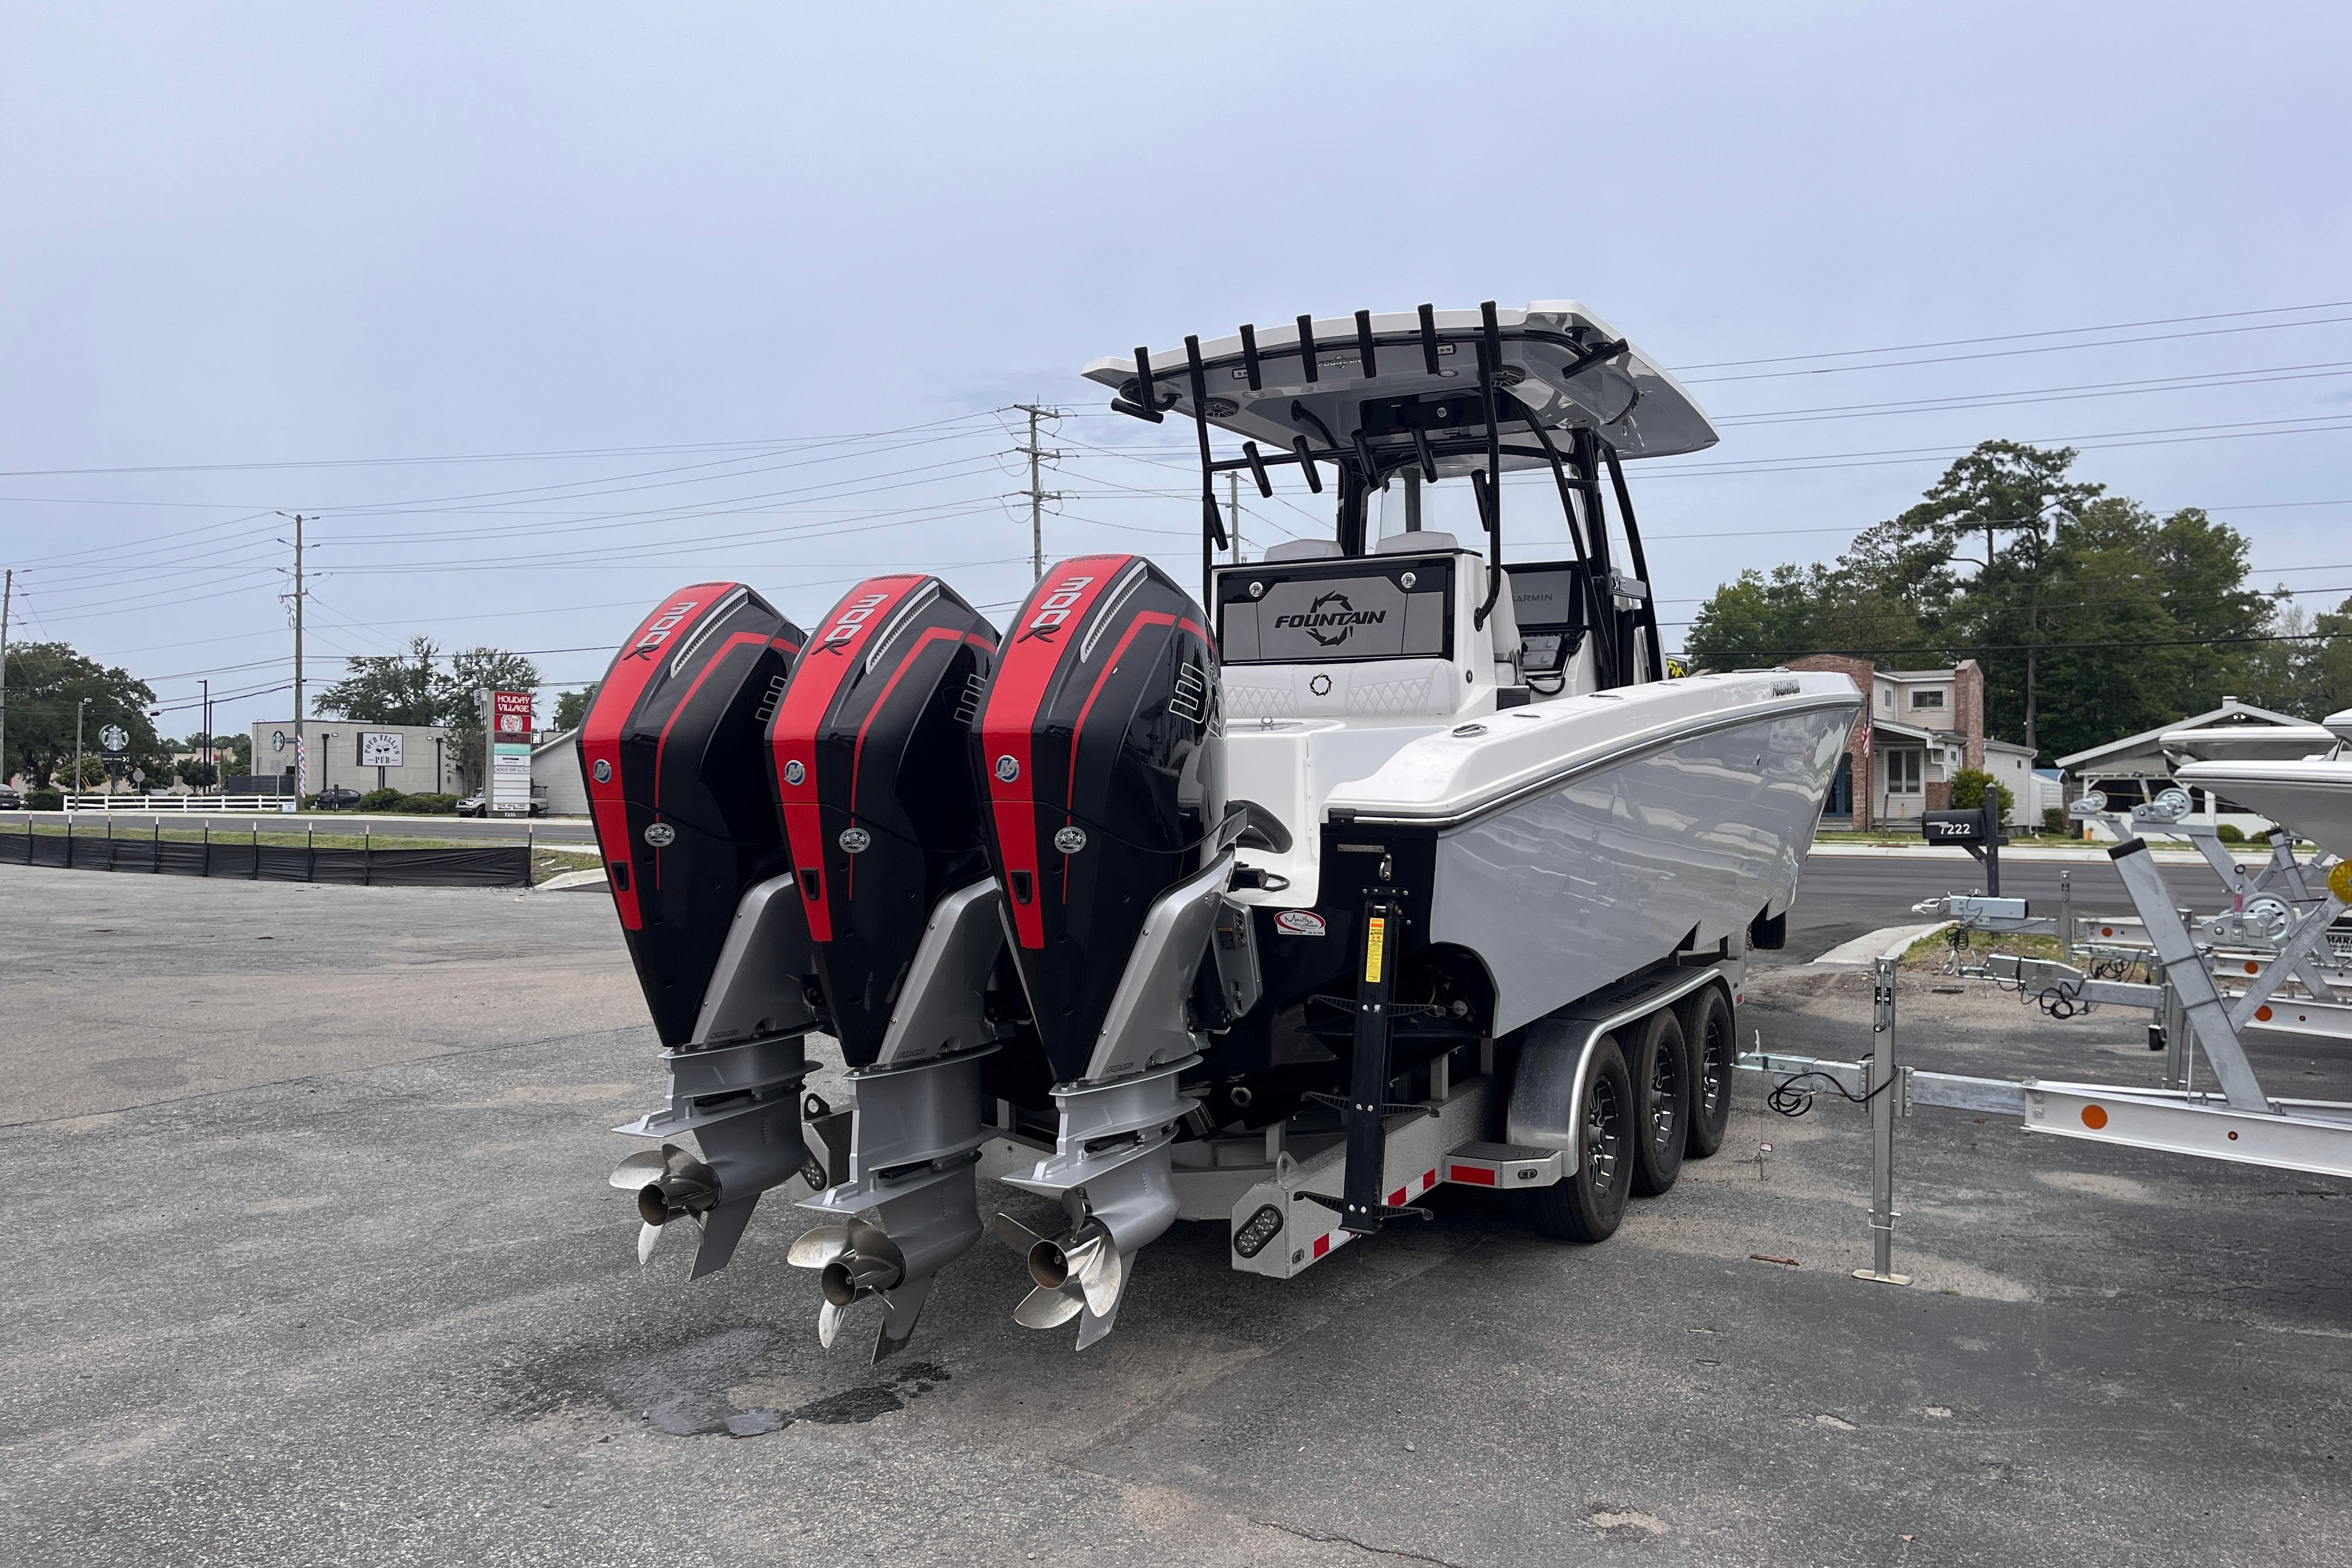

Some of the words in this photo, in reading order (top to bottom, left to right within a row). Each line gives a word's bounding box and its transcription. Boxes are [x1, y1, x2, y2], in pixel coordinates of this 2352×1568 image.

[1275, 611, 1386, 628] FOUNTAIN
[498, 695, 530, 704] HOLIDAY
[498, 704, 530, 712] VILLAGE
